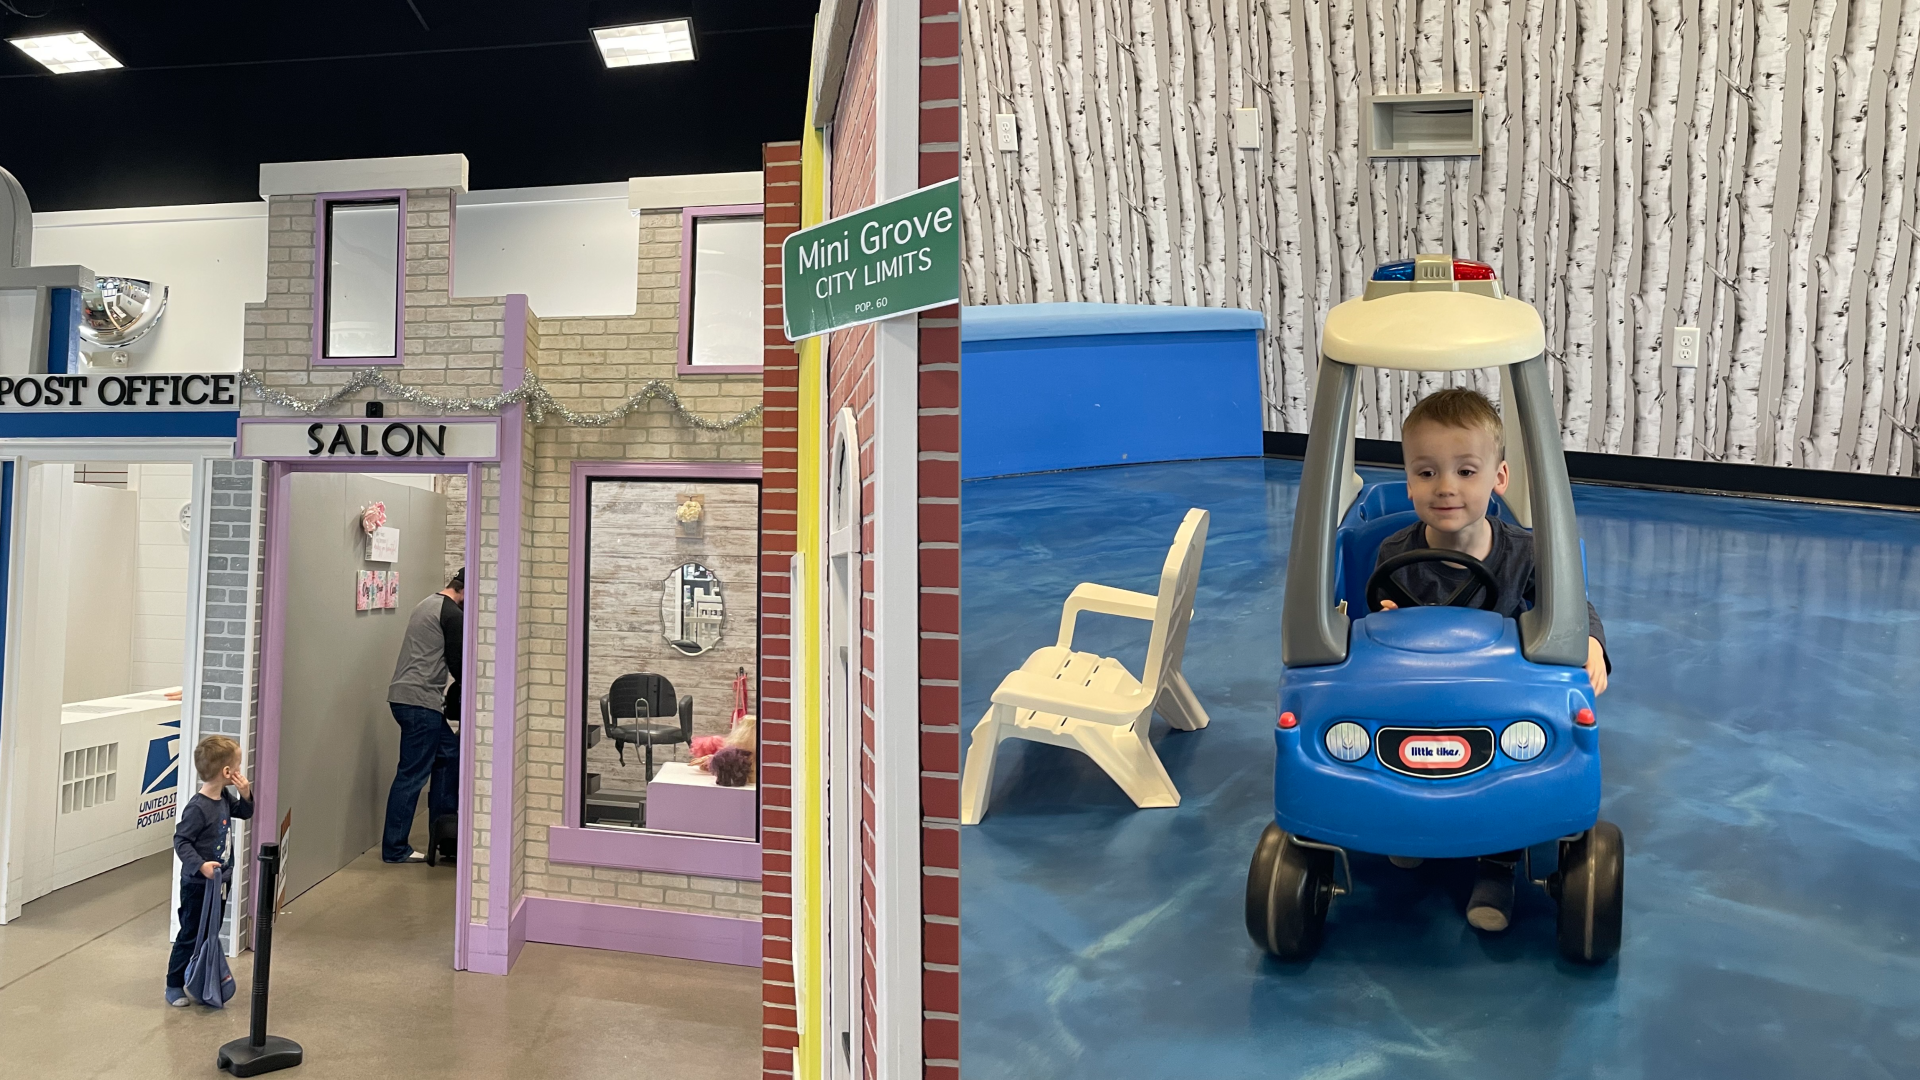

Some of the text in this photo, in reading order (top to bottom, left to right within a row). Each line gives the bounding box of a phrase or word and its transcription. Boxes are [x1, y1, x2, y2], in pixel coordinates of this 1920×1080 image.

[798, 206, 953, 275] Mini Grove
[815, 247, 932, 299] CITY LIMITS
[854, 297, 888, 314] POP. 60
[0, 375, 235, 407] POST OFFICE
[307, 422, 447, 457] SALON
[1411, 747, 1433, 756] little
[139, 794, 169, 813] UNITED
[136, 811, 165, 830] POSTAL
